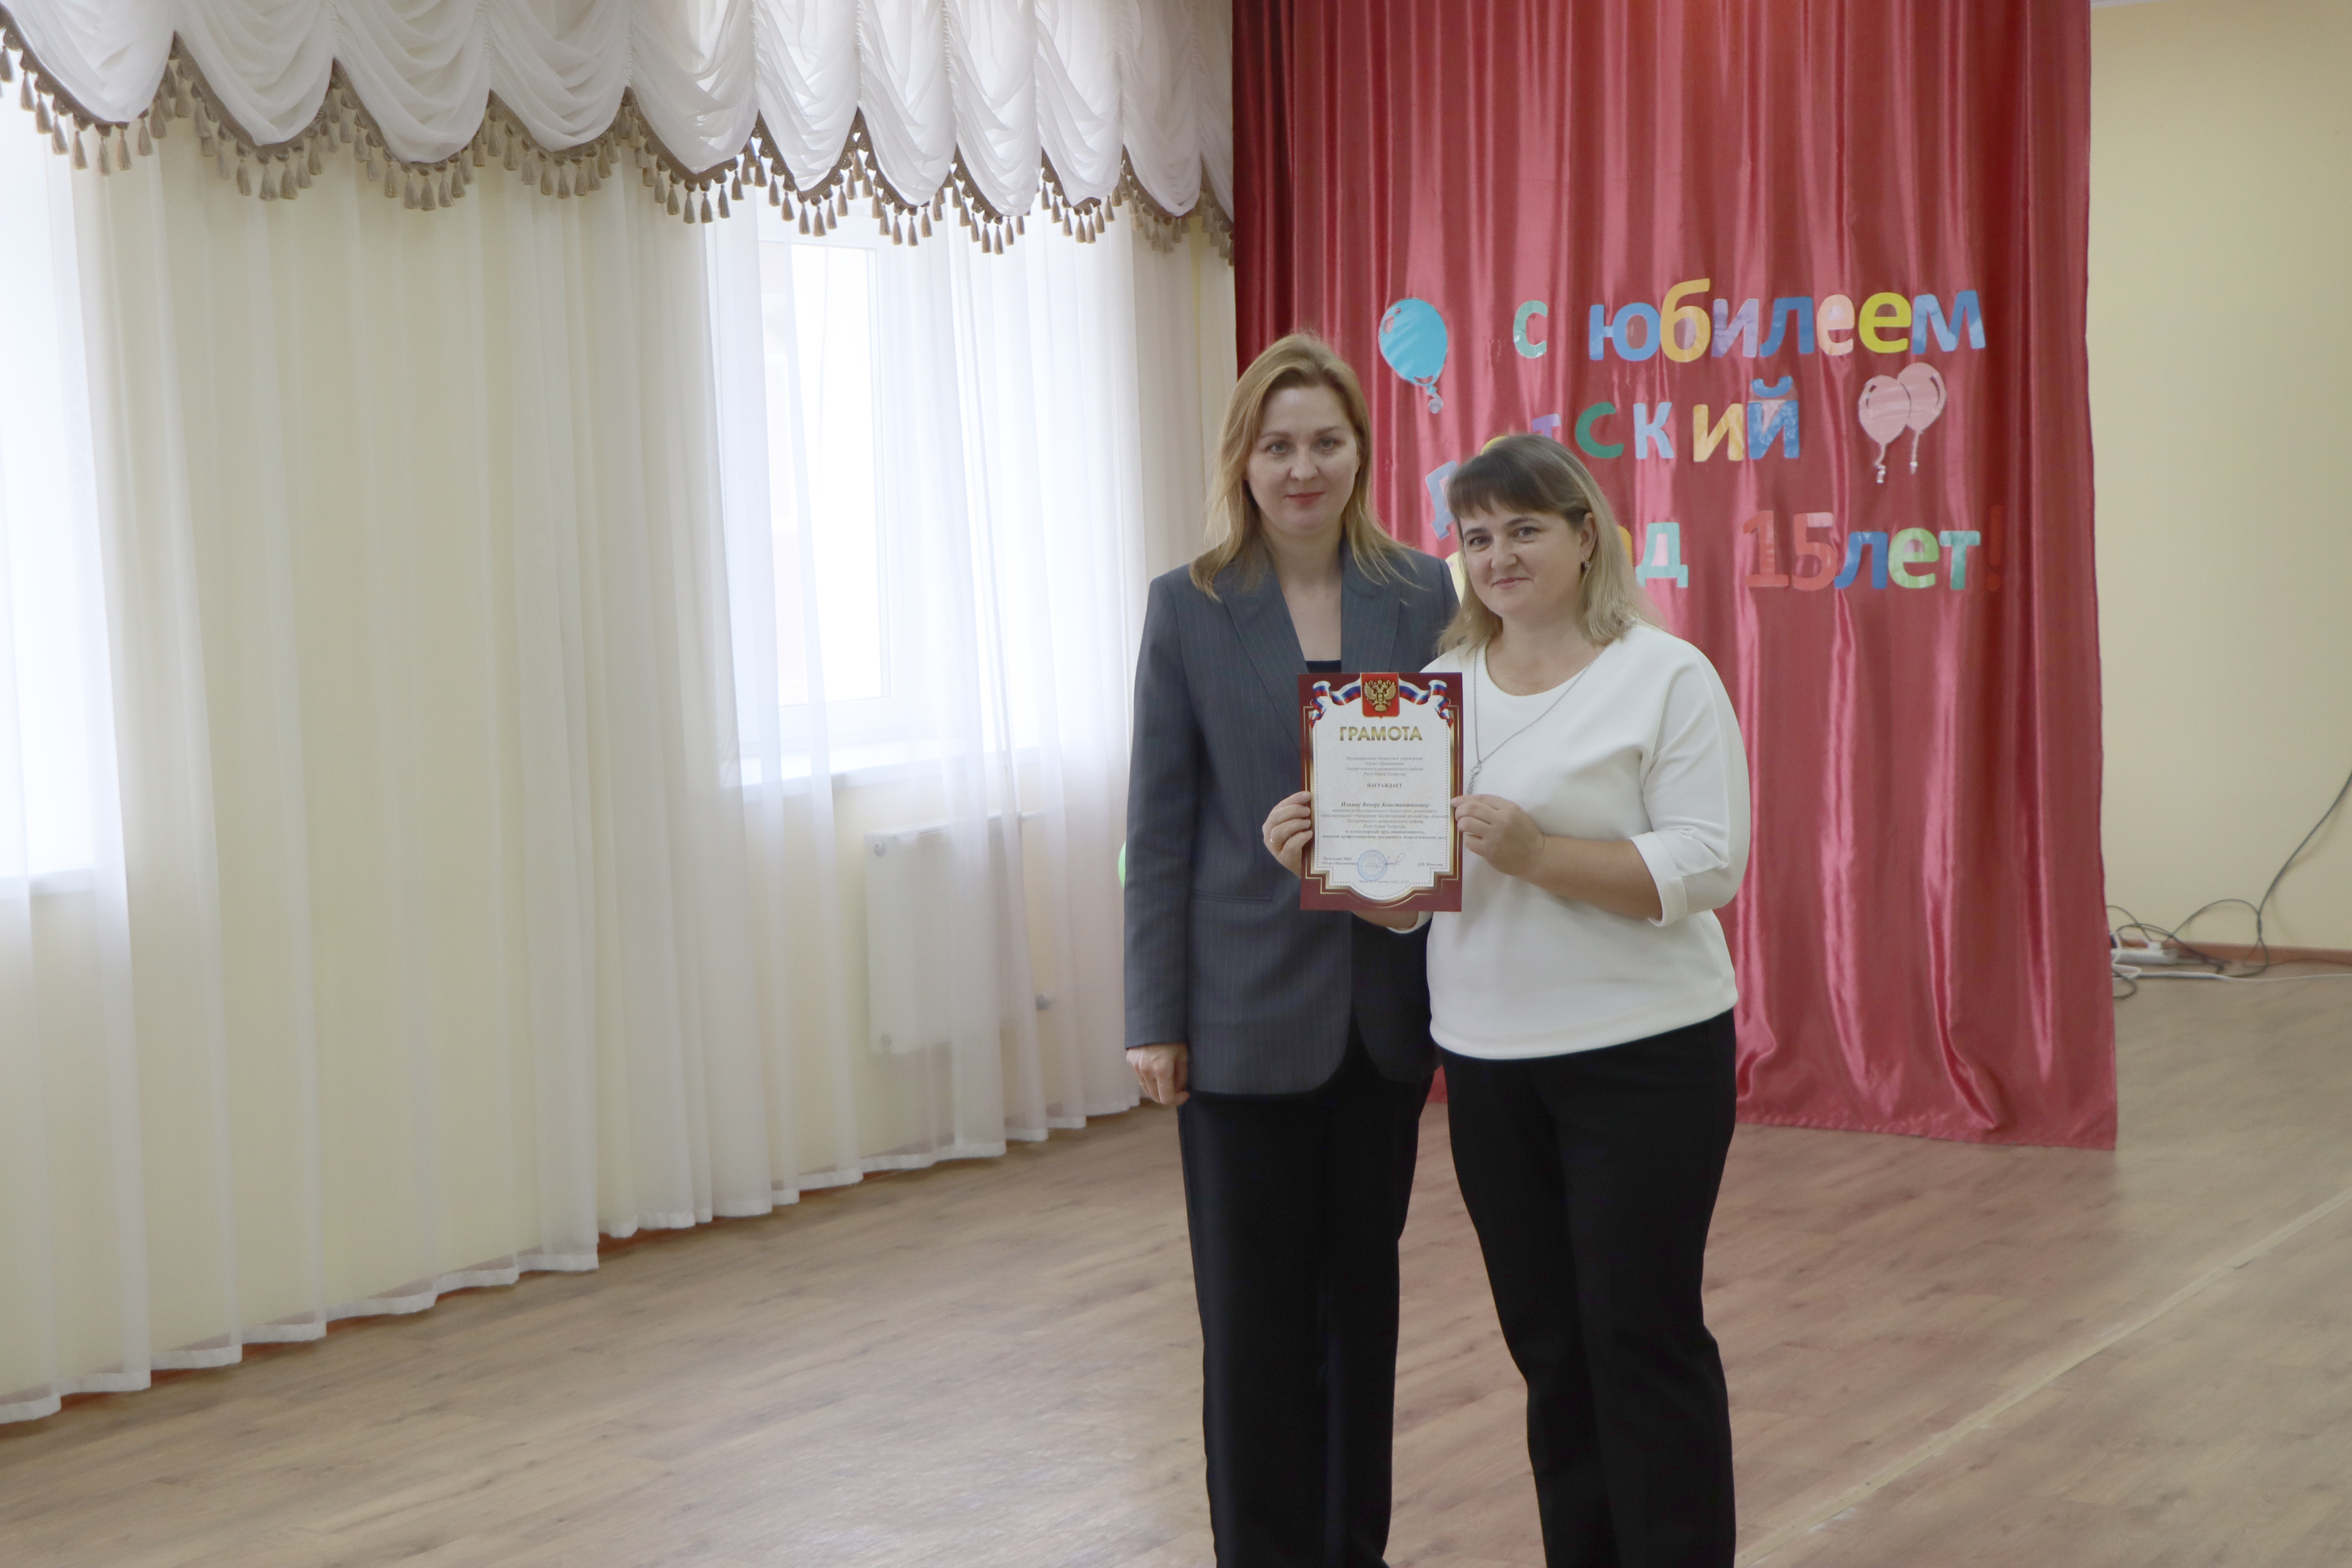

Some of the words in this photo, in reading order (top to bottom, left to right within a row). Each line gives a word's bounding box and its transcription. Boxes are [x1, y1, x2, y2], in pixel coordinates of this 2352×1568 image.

[1513, 299, 1548, 358] с
[1588, 278, 1985, 363] юбилеем
[1339, 726, 1423, 741] ГРАМОТА
